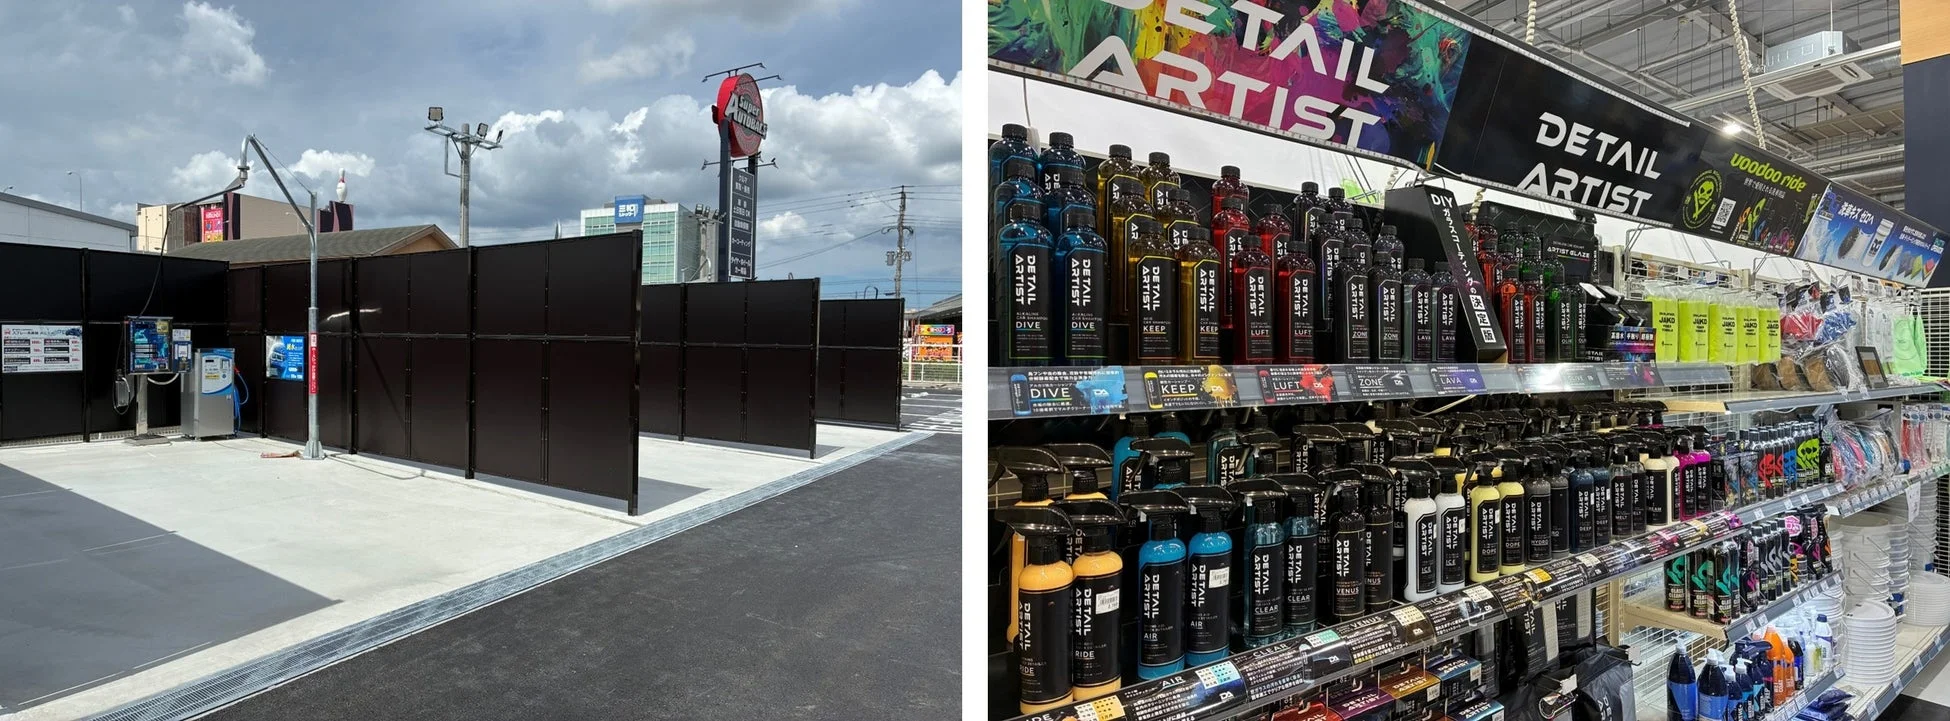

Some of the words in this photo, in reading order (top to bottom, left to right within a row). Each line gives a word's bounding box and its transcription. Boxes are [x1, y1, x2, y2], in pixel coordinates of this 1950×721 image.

[1114, 0, 1390, 93] ETAIL
[1067, 35, 1381, 149] ARTIST
[740, 95, 760, 117] Super
[725, 92, 768, 139] AUTOBACS
[1536, 112, 1661, 179] DETAIL
[1731, 153, 1782, 182] voodoo
[1781, 175, 1807, 192] ride
[1516, 162, 1653, 216] ARTIST
[1430, 194, 1453, 208] DIY
[1547, 246, 1569, 255] ARTIST
[1569, 250, 1590, 258] GLAZE
[1015, 254, 1024, 305] ARTIST
[1027, 255, 1036, 305] DETAIL
[1071, 258, 1080, 306] ARTIST
[1082, 259, 1091, 306] DETAIL
[1142, 265, 1150, 311] ARTIST
[1152, 266, 1160, 311] DETAIL
[1249, 276, 1257, 317] ARTIST
[1016, 321, 1041, 329] DIVE
[1273, 381, 1300, 390] LUFT
[1359, 378, 1384, 386] ZONE
[1440, 377, 1462, 385] LAVA
[1030, 387, 1071, 399] DIVE
[1161, 384, 1195, 394] KEEP
[1198, 564, 1206, 607] DETAIL
[1336, 586, 1360, 594] VENUS
[1288, 594, 1311, 602] CLEAR
[1084, 588, 1092, 636] DETAIL
[1254, 604, 1279, 613] CLEAR
[1350, 615, 1383, 628] VENUS
[1075, 650, 1095, 658] RIDE
[1252, 643, 1288, 657] CLEAR
[1162, 676, 1184, 687] AIR
[1392, 675, 1424, 689] DETAIL
[1398, 679, 1427, 692] ARTIST
[1341, 693, 1377, 708] DETAIL
[1348, 696, 1380, 711] ARTIST
